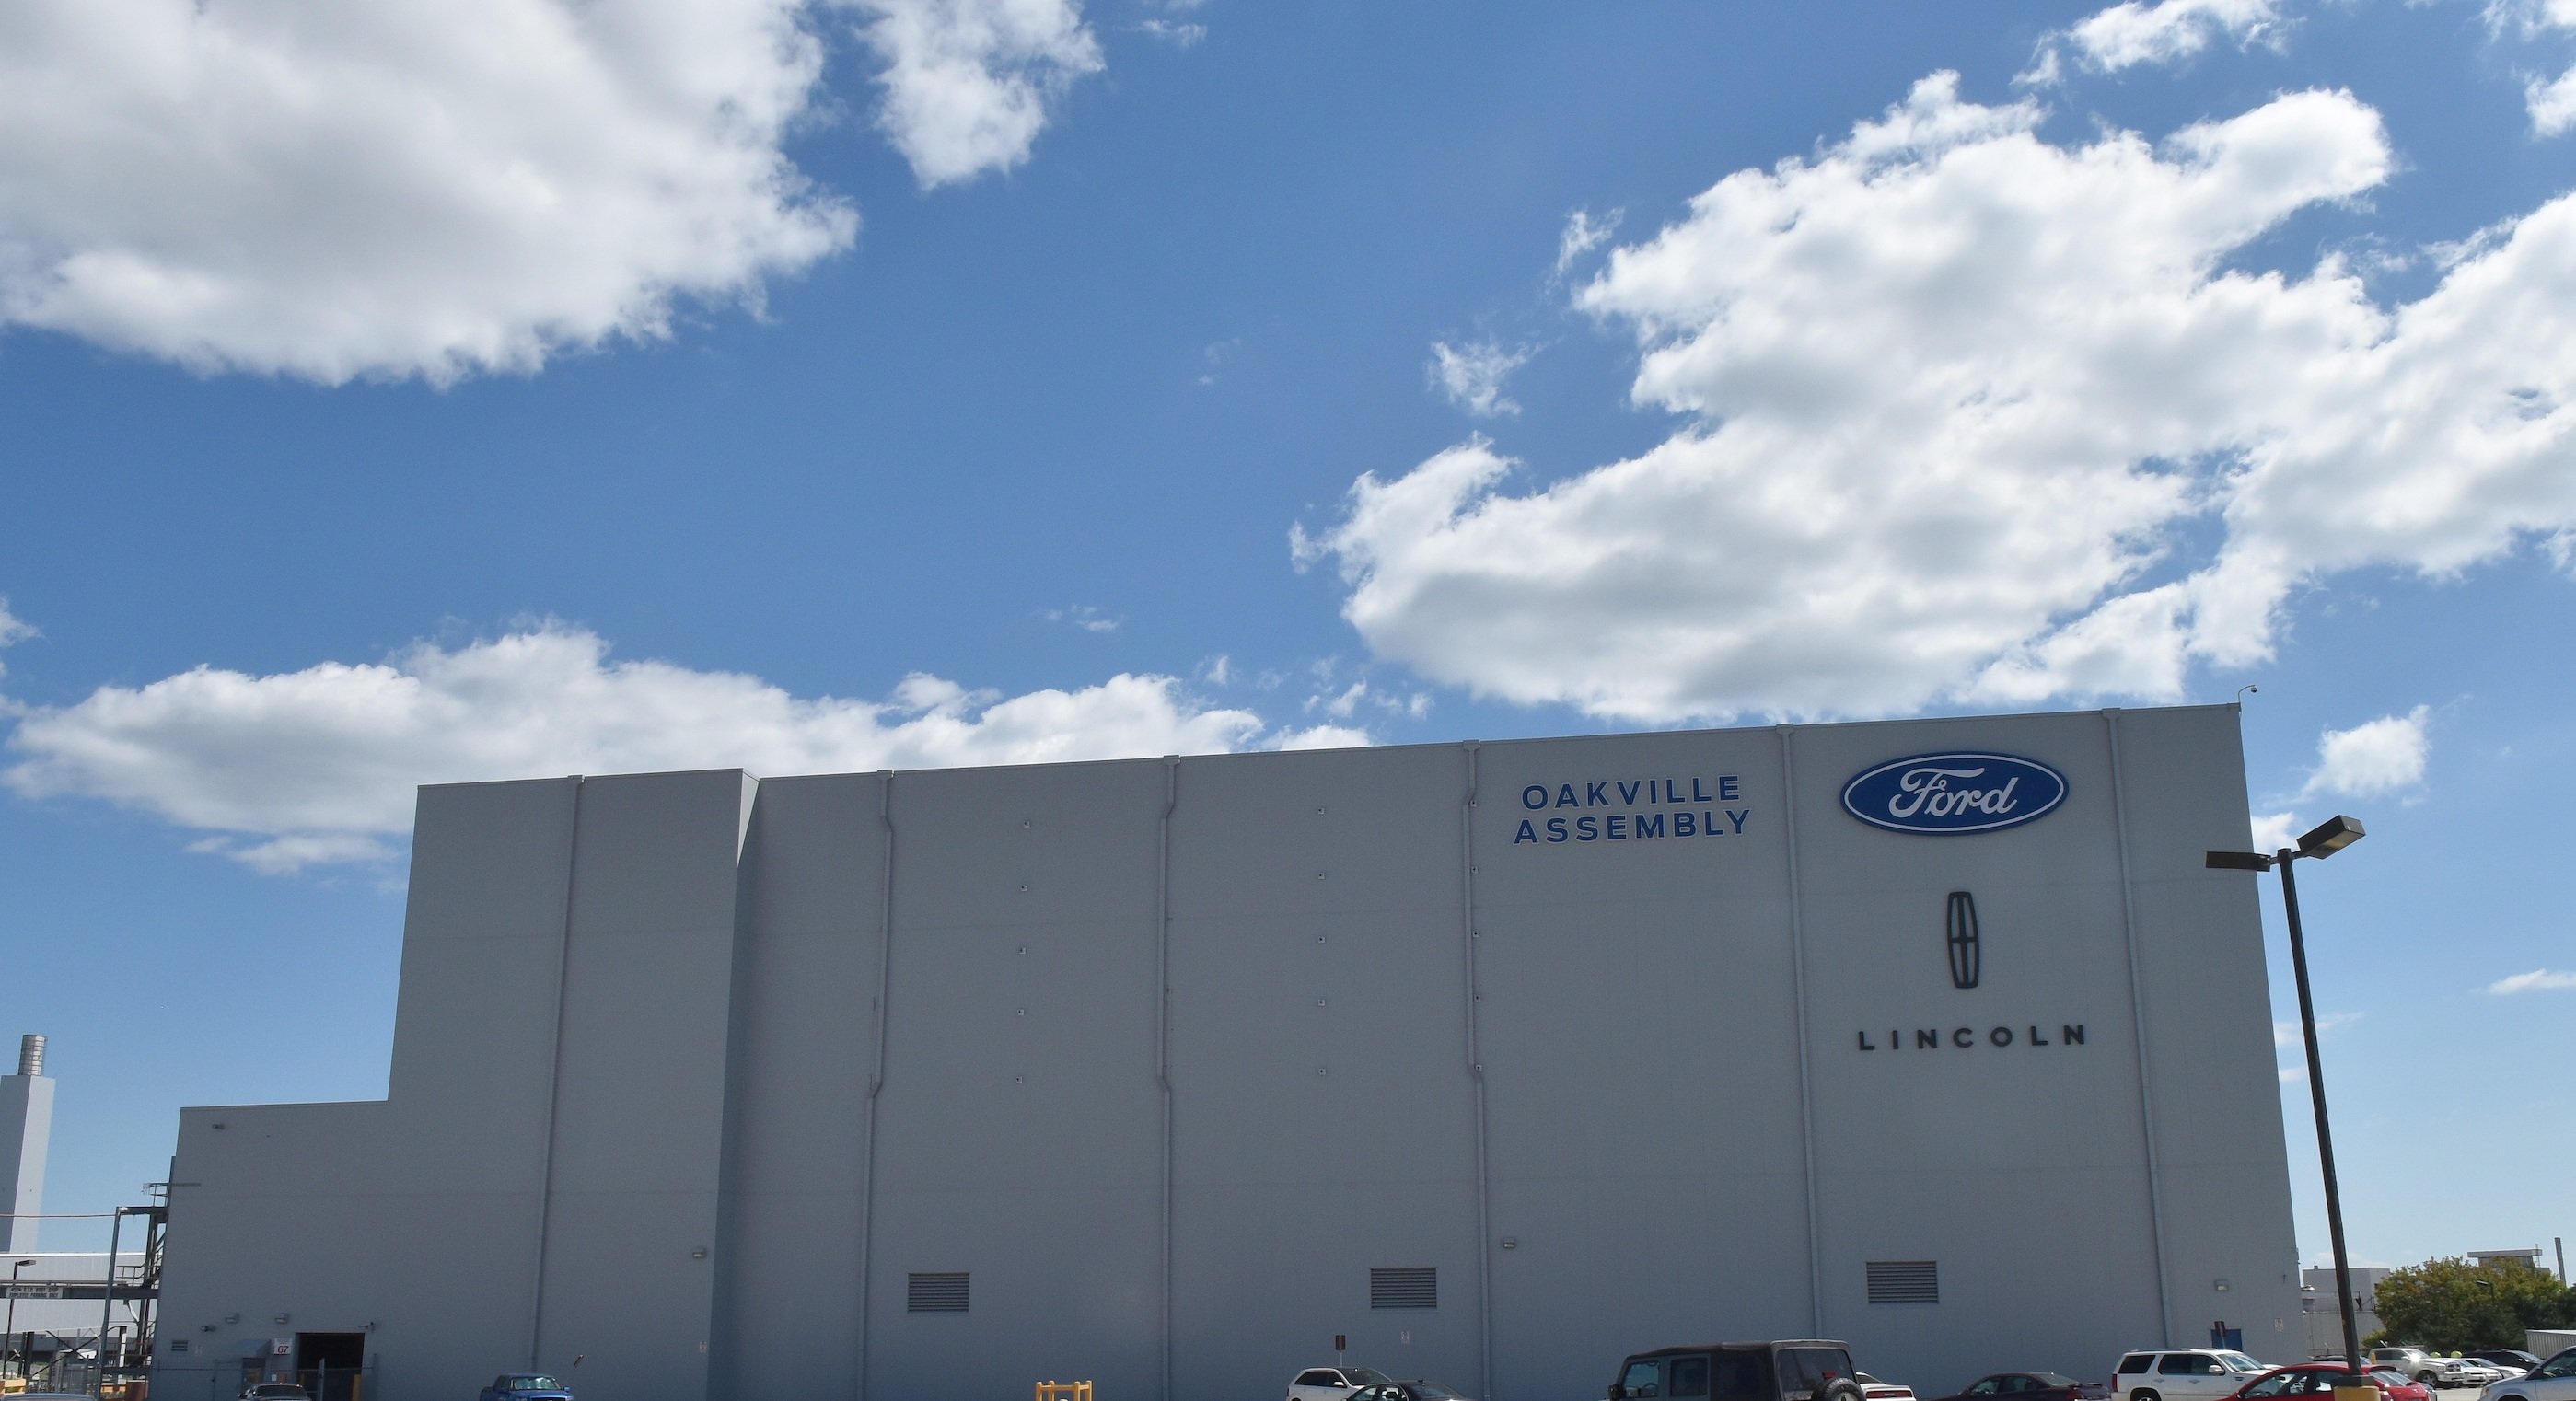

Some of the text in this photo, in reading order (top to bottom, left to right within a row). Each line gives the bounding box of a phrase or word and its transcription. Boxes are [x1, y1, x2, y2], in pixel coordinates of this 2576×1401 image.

[1521, 775, 1740, 811] OAKVILLE
[1888, 768, 2019, 817] Ford
[1513, 809, 1752, 845] ASSEMBLY
[1858, 1025, 2084, 1051] LINCOLN
[278, 1345, 288, 1353] 67
